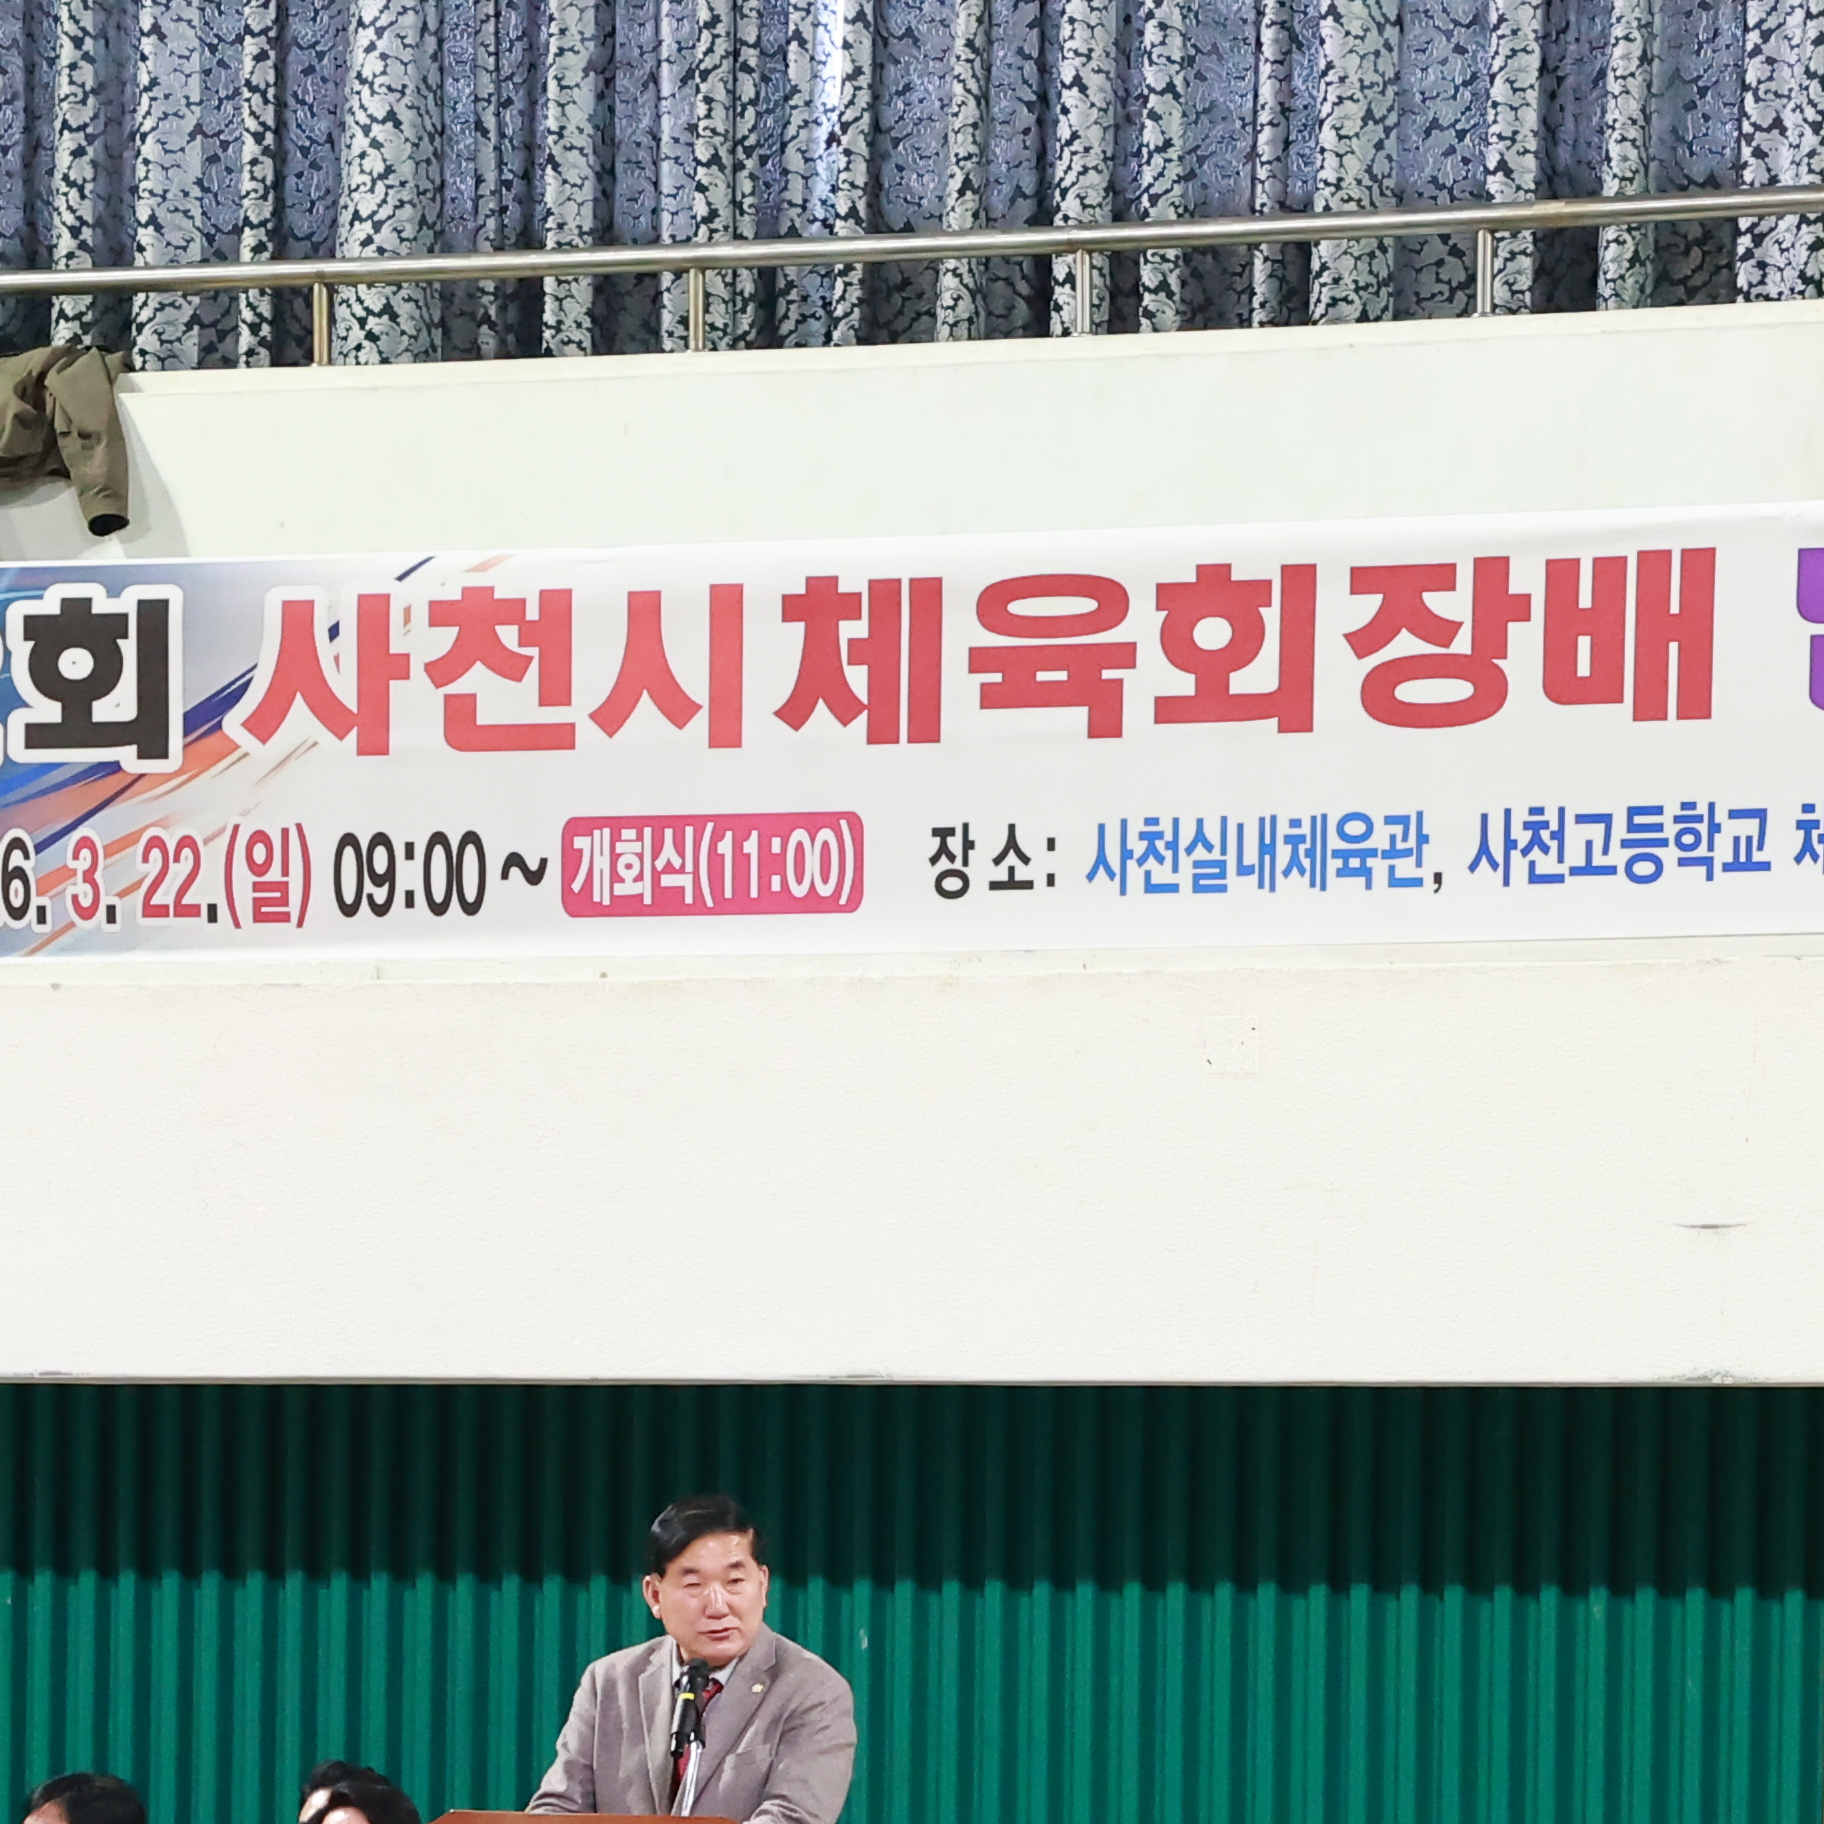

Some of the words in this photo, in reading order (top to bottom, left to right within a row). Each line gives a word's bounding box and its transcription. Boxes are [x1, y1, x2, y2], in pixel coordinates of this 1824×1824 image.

[240, 546, 1717, 756] 사천시체육회장배
[71, 835, 117, 925] 3.
[571, 819, 855, 907] 개회식(11:00)
[1085, 810, 1443, 896] 사천실내체육관,
[1467, 800, 1771, 887] 사천고등학교
